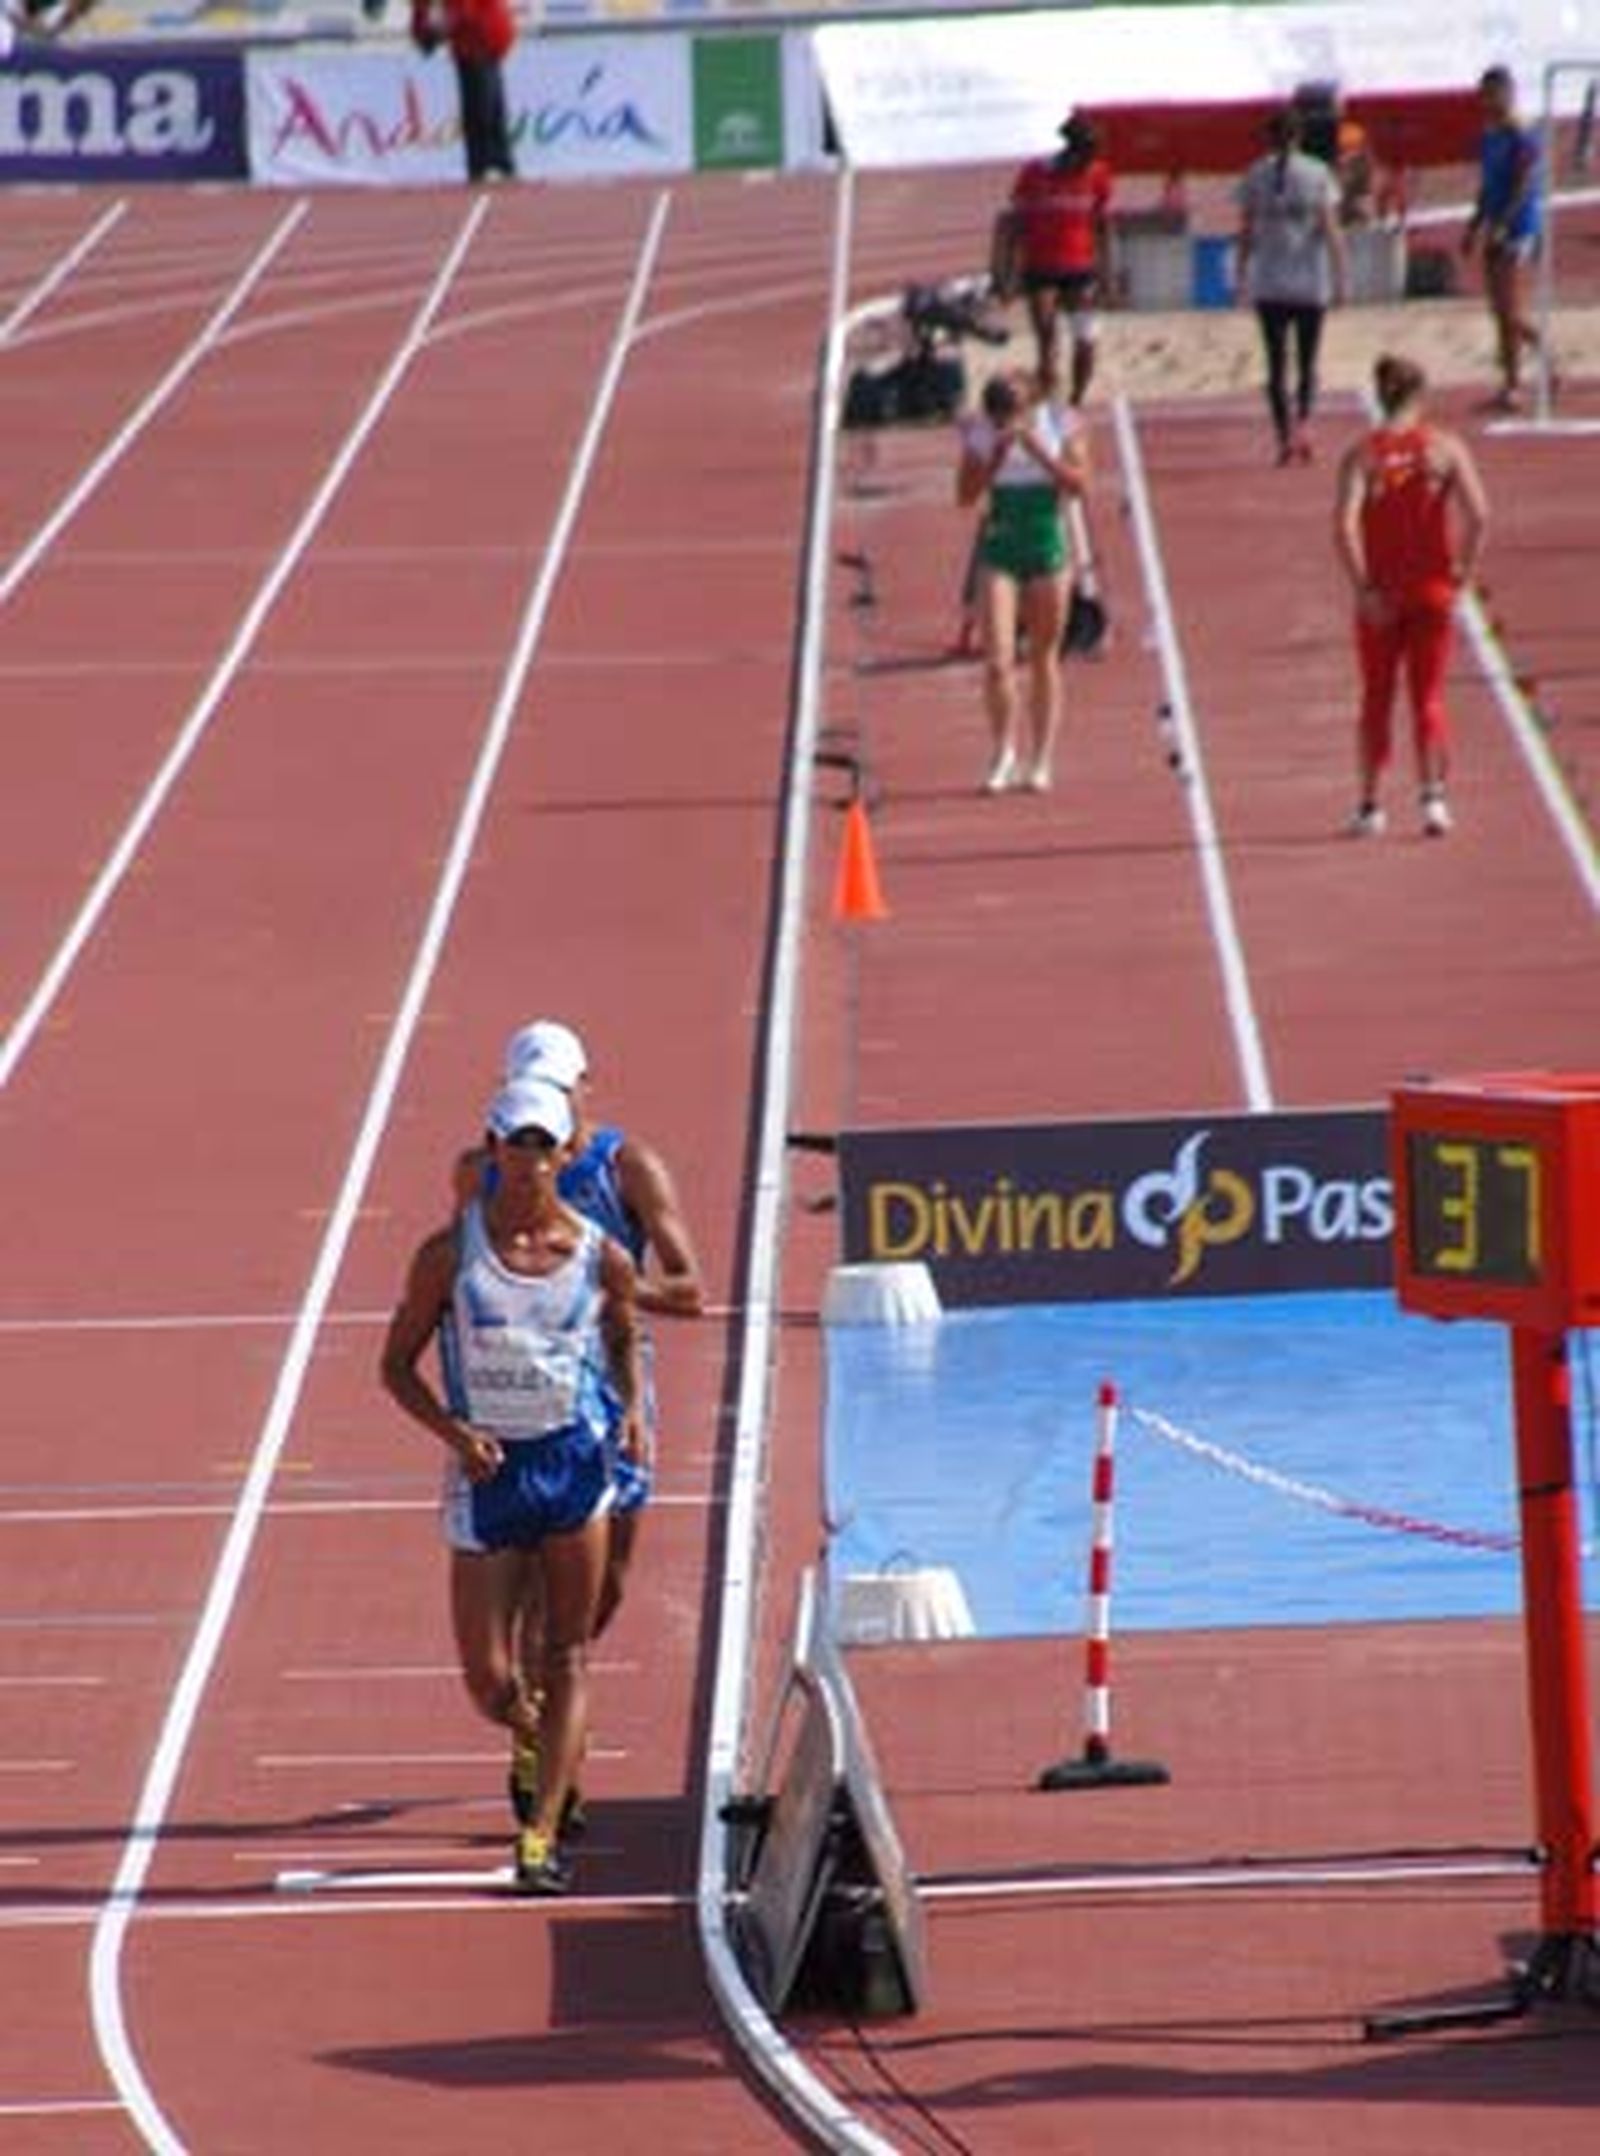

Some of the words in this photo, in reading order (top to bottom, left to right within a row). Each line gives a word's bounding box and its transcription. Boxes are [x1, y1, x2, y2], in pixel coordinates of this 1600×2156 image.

[868, 1178, 1114, 1257] Divina
[1260, 1165, 1395, 1242] Pas
[1435, 1144, 1541, 1272] 37
